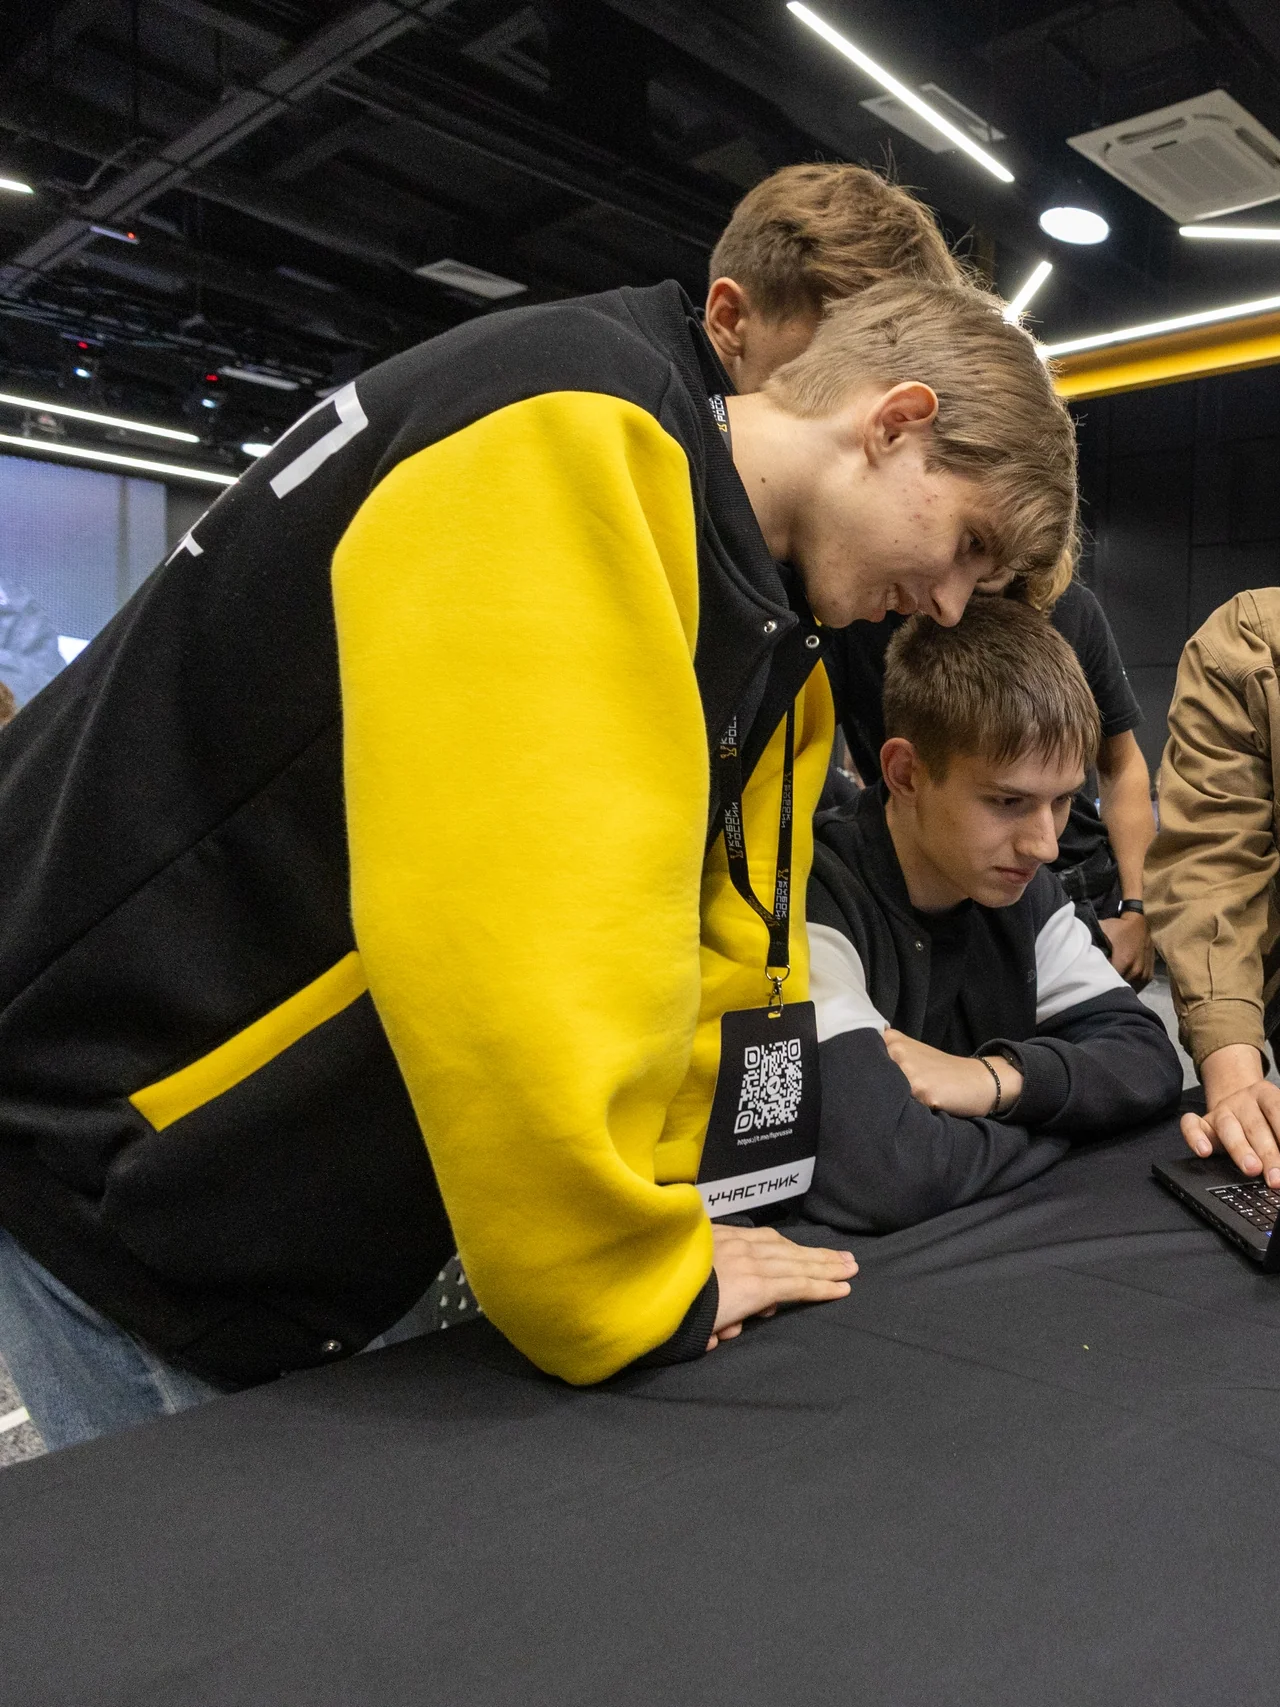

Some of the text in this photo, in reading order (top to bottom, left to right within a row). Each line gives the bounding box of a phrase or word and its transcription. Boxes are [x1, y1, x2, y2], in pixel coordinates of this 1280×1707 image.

[725, 809, 735, 847] КУБОК
[731, 802, 743, 848] РОССИИ
[708, 1173, 799, 1206] УЧАСТНИК
